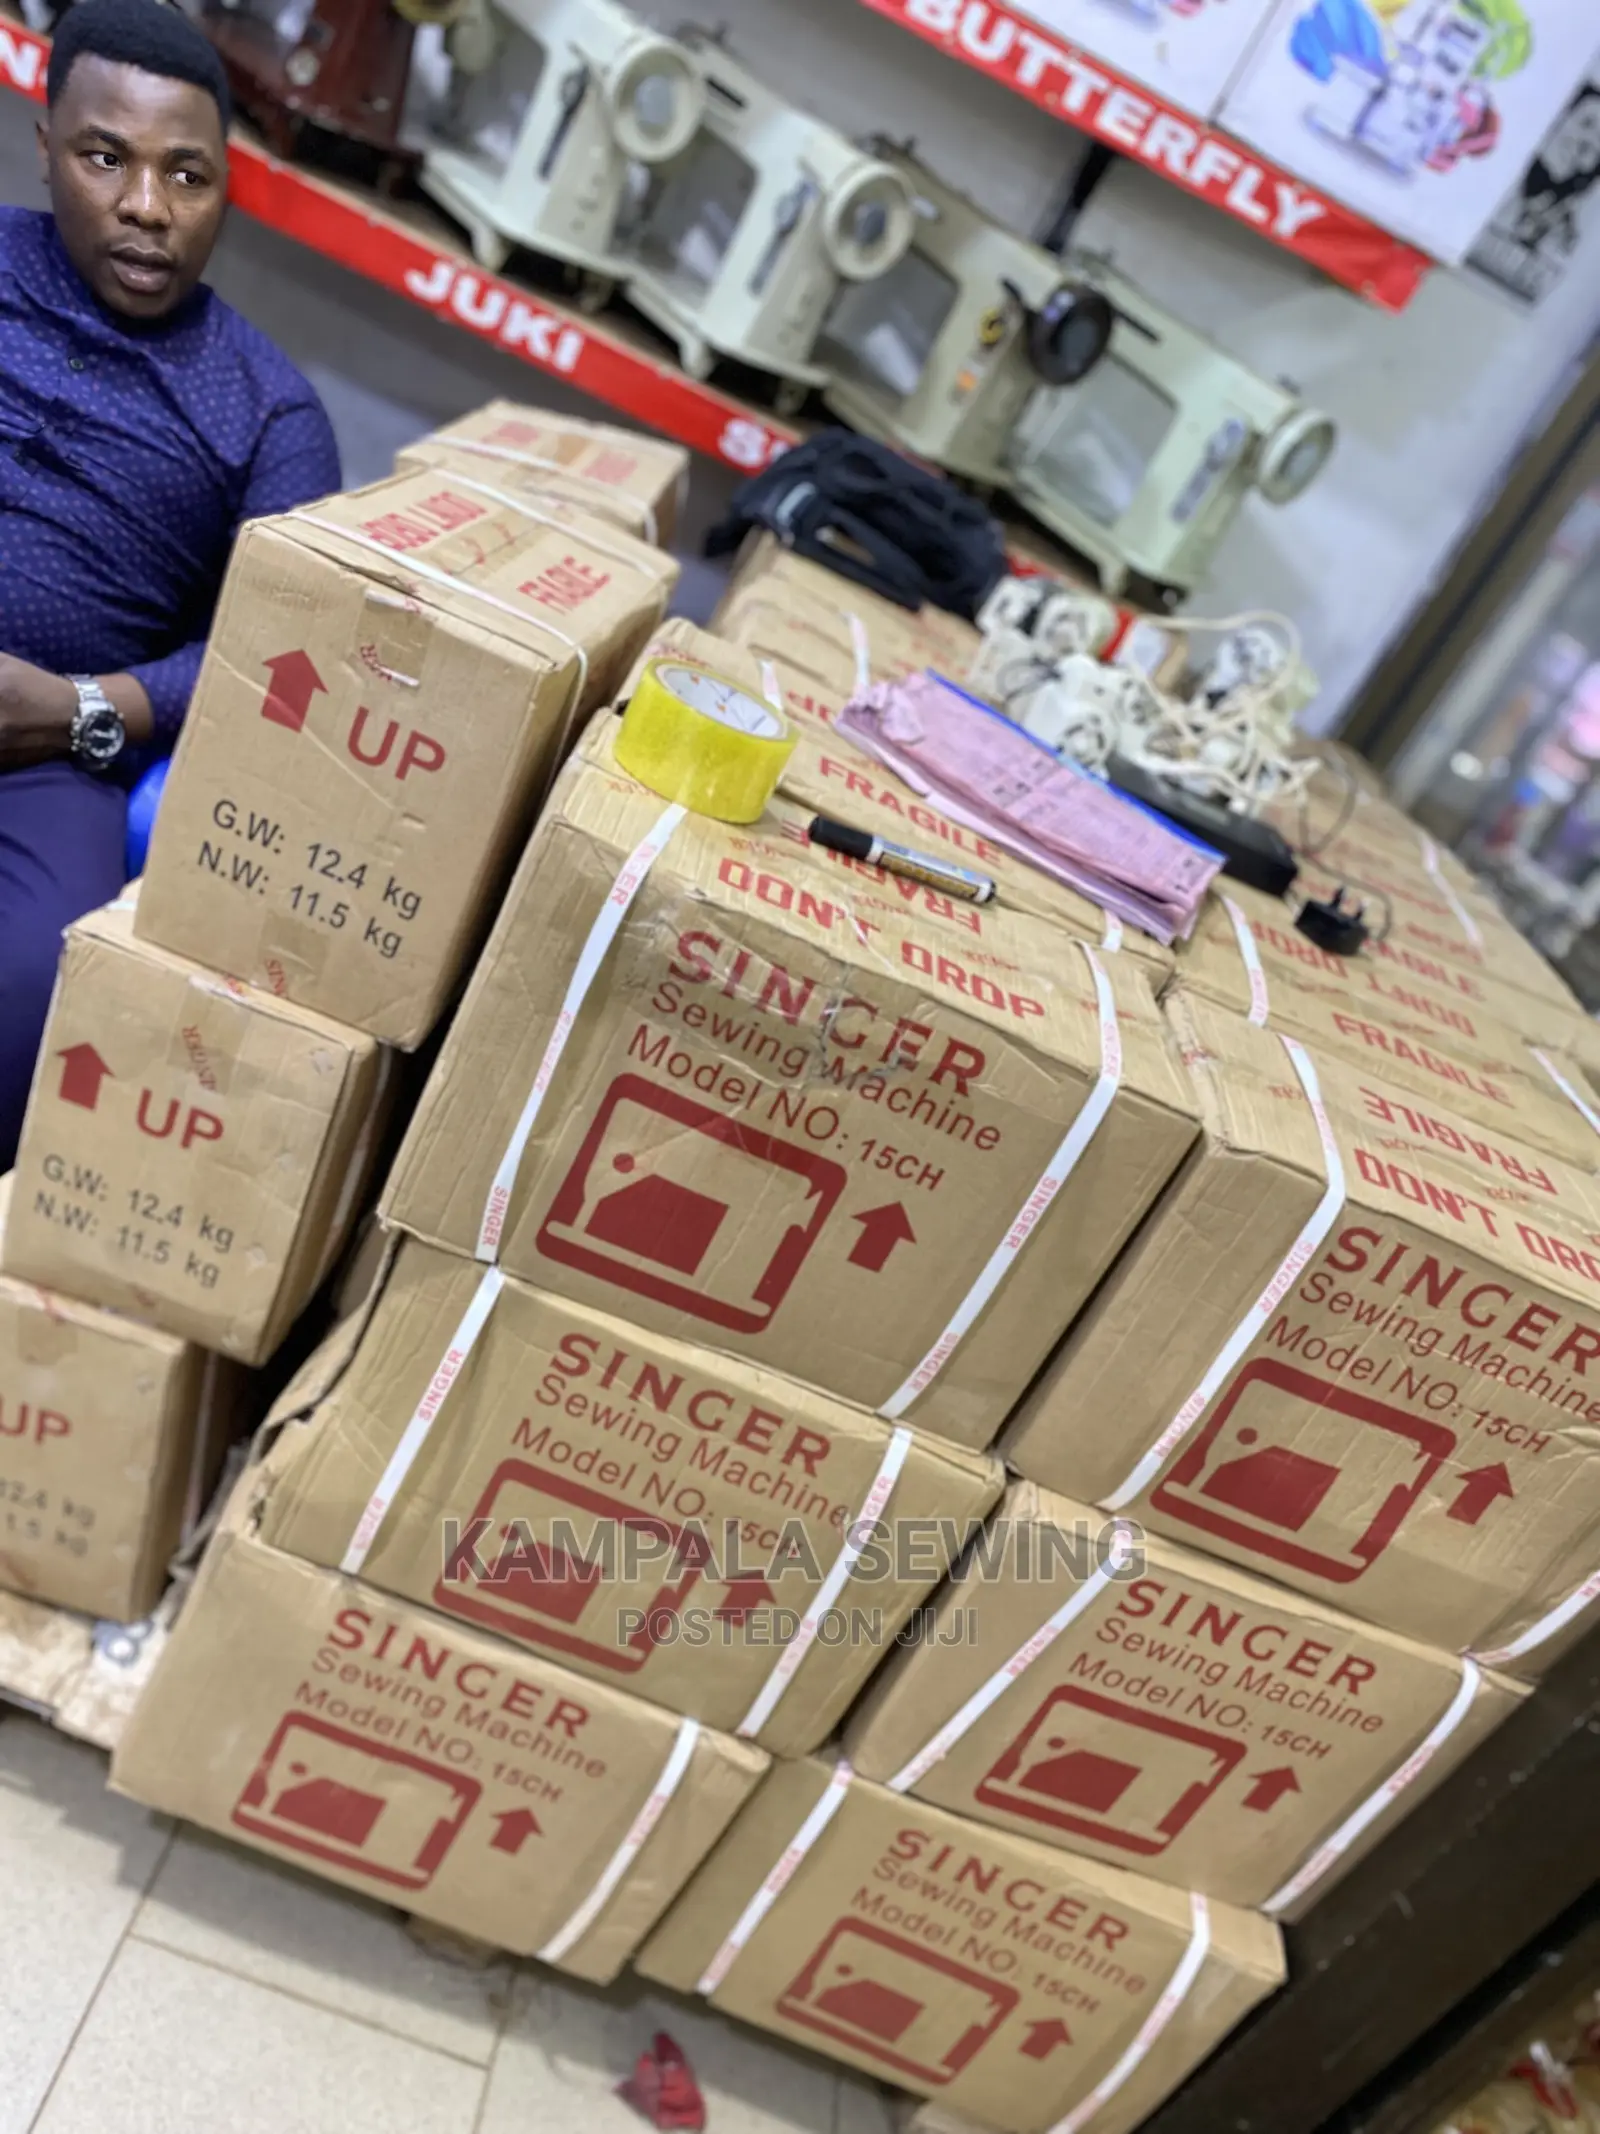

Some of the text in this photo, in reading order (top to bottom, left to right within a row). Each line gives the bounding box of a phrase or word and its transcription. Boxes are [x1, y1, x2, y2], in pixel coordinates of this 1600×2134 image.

[905, 0, 1327, 238] BUTTERFLY
[405, 259, 587, 374] JUKI
[346, 706, 446, 781] UP
[211, 798, 423, 921] G.W: 12.4 kg
[819, 756, 1003, 869] FRAGILE
[197, 839, 404, 960] N.W: 11.5 kg
[718, 857, 881, 948] DON'T
[901, 940, 1046, 1021] DROP
[651, 981, 1002, 1152] Sewing Machine
[666, 929, 987, 1098] SINGER
[1331, 1011, 1516, 1110] FRAGILE
[136, 1088, 224, 1150] UP
[626, 1022, 946, 1193] Model NO: 15CH
[1359, 1085, 1559, 1196] FRAGILE
[33, 1190, 220, 1289] N.W: 11.5 kg
[42, 1153, 235, 1254] G.W: 12.4 kg
[482, 1185, 508, 1247] SINGER
[1004, 1175, 1059, 1249] SINGER
[1354, 1146, 1499, 1238] DON'T
[1300, 1272, 1443, 1357] Sewing
[1324, 1226, 1600, 1376] SINGER
[0, 1392, 74, 1446] UP
[417, 1349, 464, 1422] SINGER
[550, 1332, 832, 1479] SINGER
[1267, 1316, 1552, 1453] Model NO: 15CH
[511, 1417, 635, 1485] Model
[639, 1470, 715, 1531] NO:
[534, 1373, 850, 1530] Sewing Machine
[326, 1607, 591, 1741] SINGER
[1096, 1616, 1233, 1691] Sewing
[1234, 1668, 1385, 1734] Machine
[1115, 1579, 1378, 1698] SINGER
[295, 1680, 565, 1804] Model NO: 15CH
[311, 1648, 609, 1780] Sewing Machine
[1068, 1651, 1332, 1761] Model NO: 15CH
[850, 1886, 959, 1946] Model
[960, 1934, 1024, 1981] NO:
[872, 1856, 1002, 1930] Sewing
[1003, 1912, 1147, 1996] Machine
[887, 1829, 1131, 1955] SINGER
